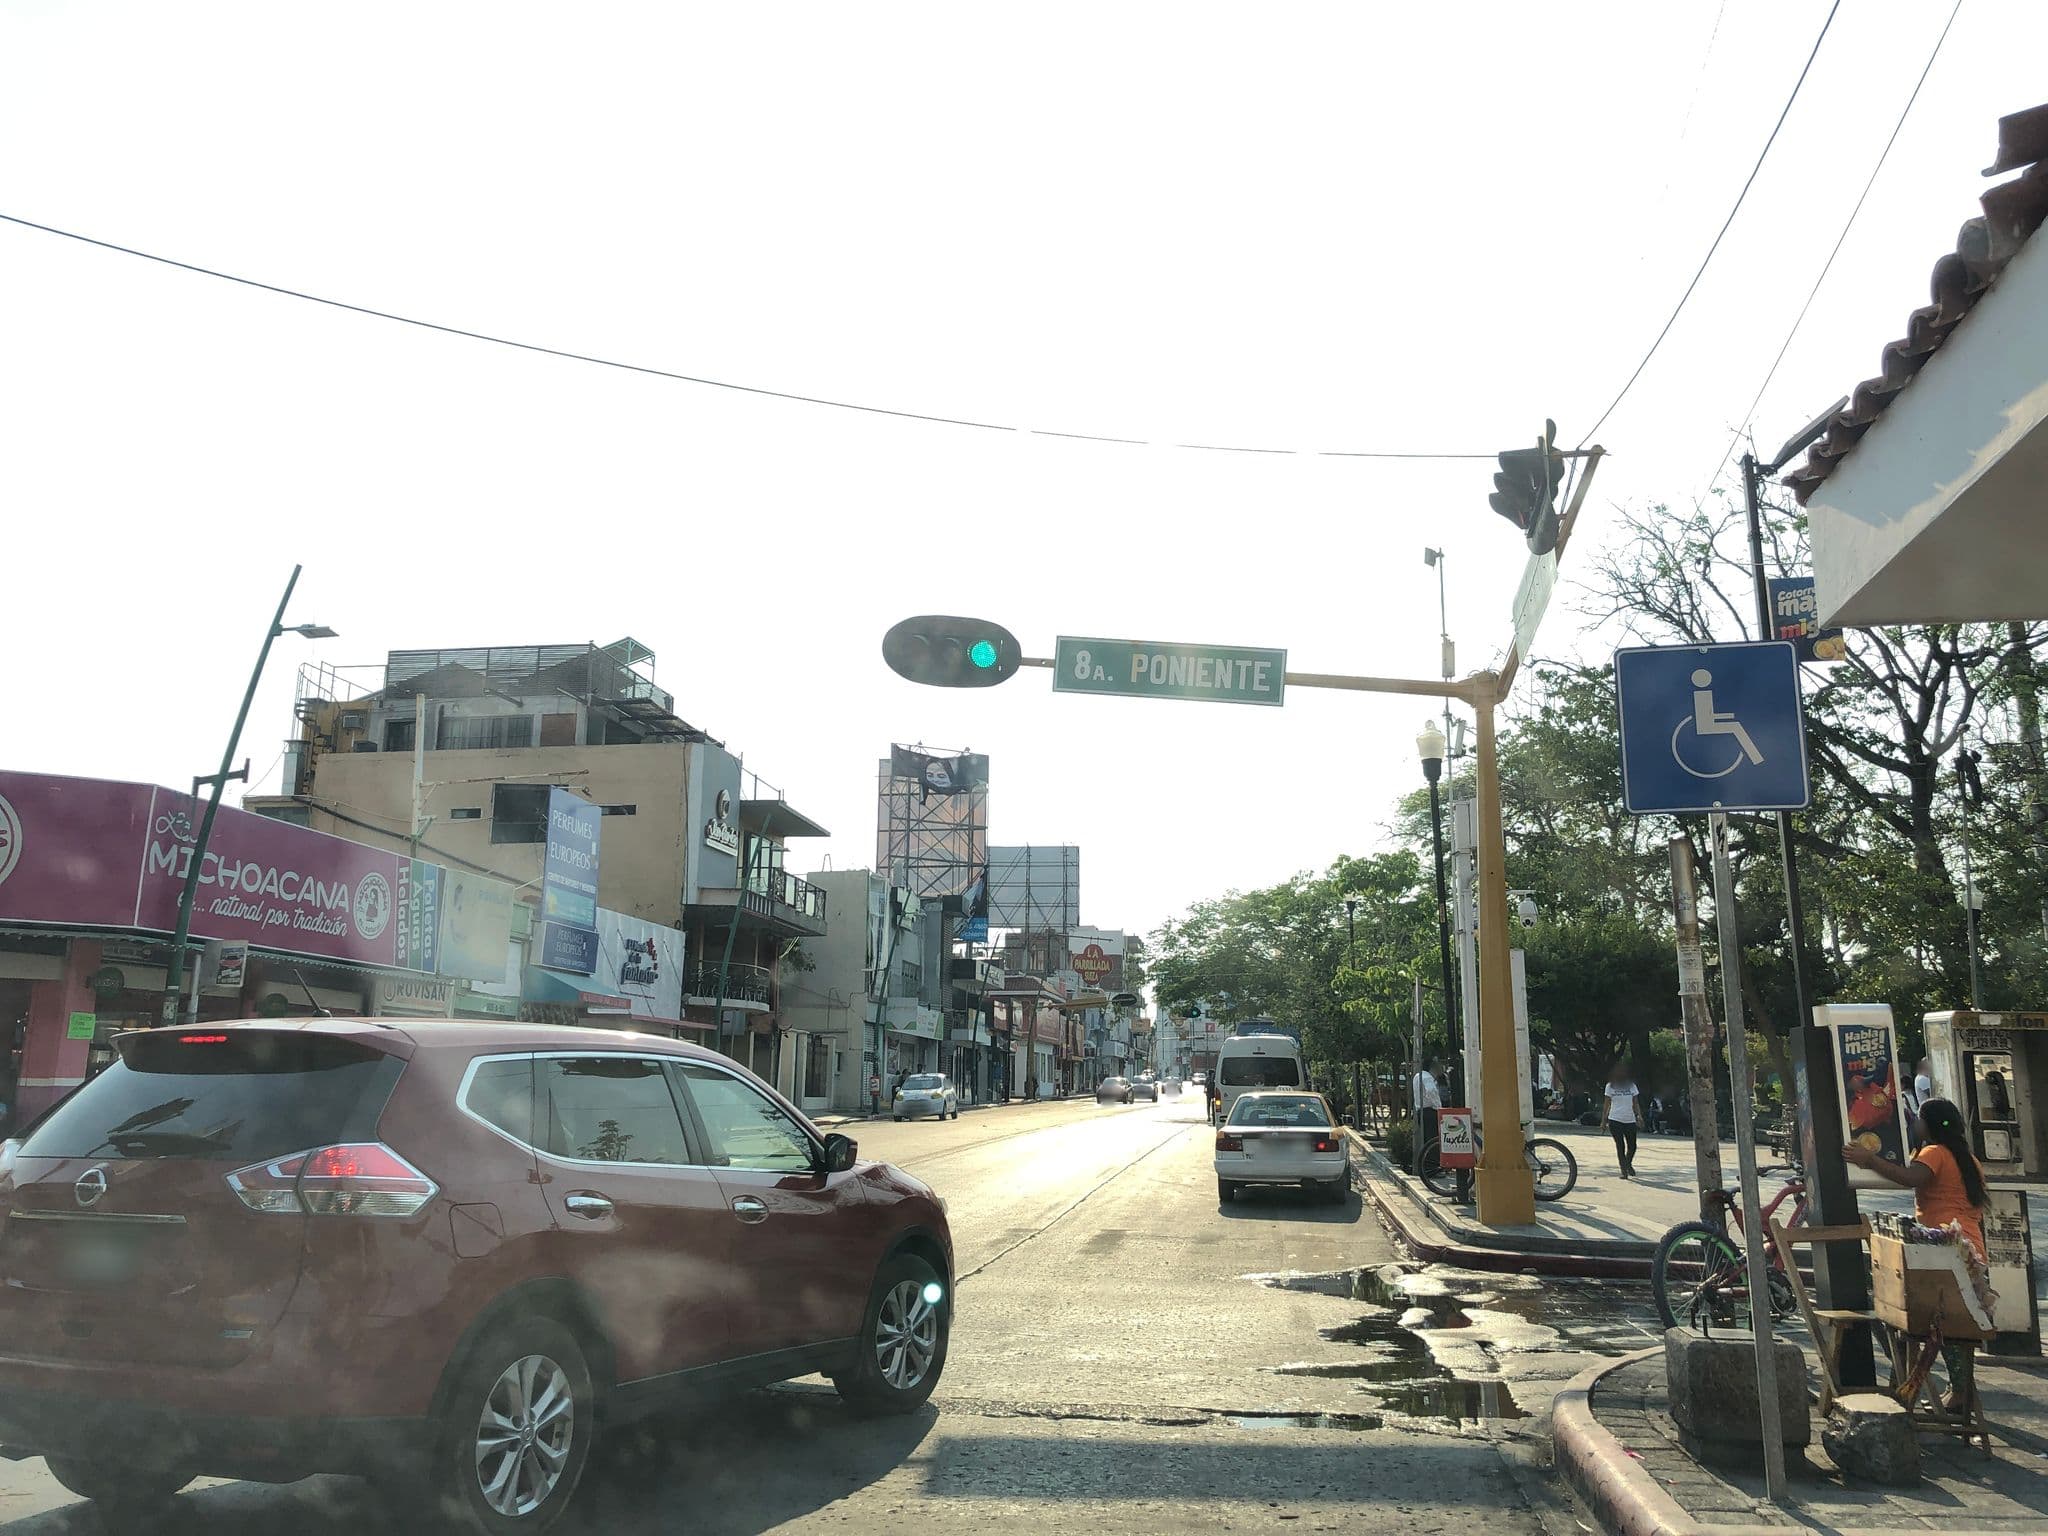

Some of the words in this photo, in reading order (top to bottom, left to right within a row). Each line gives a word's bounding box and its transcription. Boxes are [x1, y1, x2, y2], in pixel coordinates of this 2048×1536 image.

[1131, 653, 1272, 692] PONIENTE
[552, 809, 593, 840] PERFUMES
[149, 840, 349, 913] MICHOACANA
[550, 841, 591, 871] EUROPEOS
[209, 894, 264, 922] natural
[260, 908, 291, 930] por
[293, 907, 348, 937] tradición
[398, 866, 410, 960] Helados
[412, 881, 424, 951] Aguas
[424, 879, 435, 959] Paletas
[1845, 1029, 1878, 1042] Habla
[1443, 1132, 1470, 1144] Tuxtla
